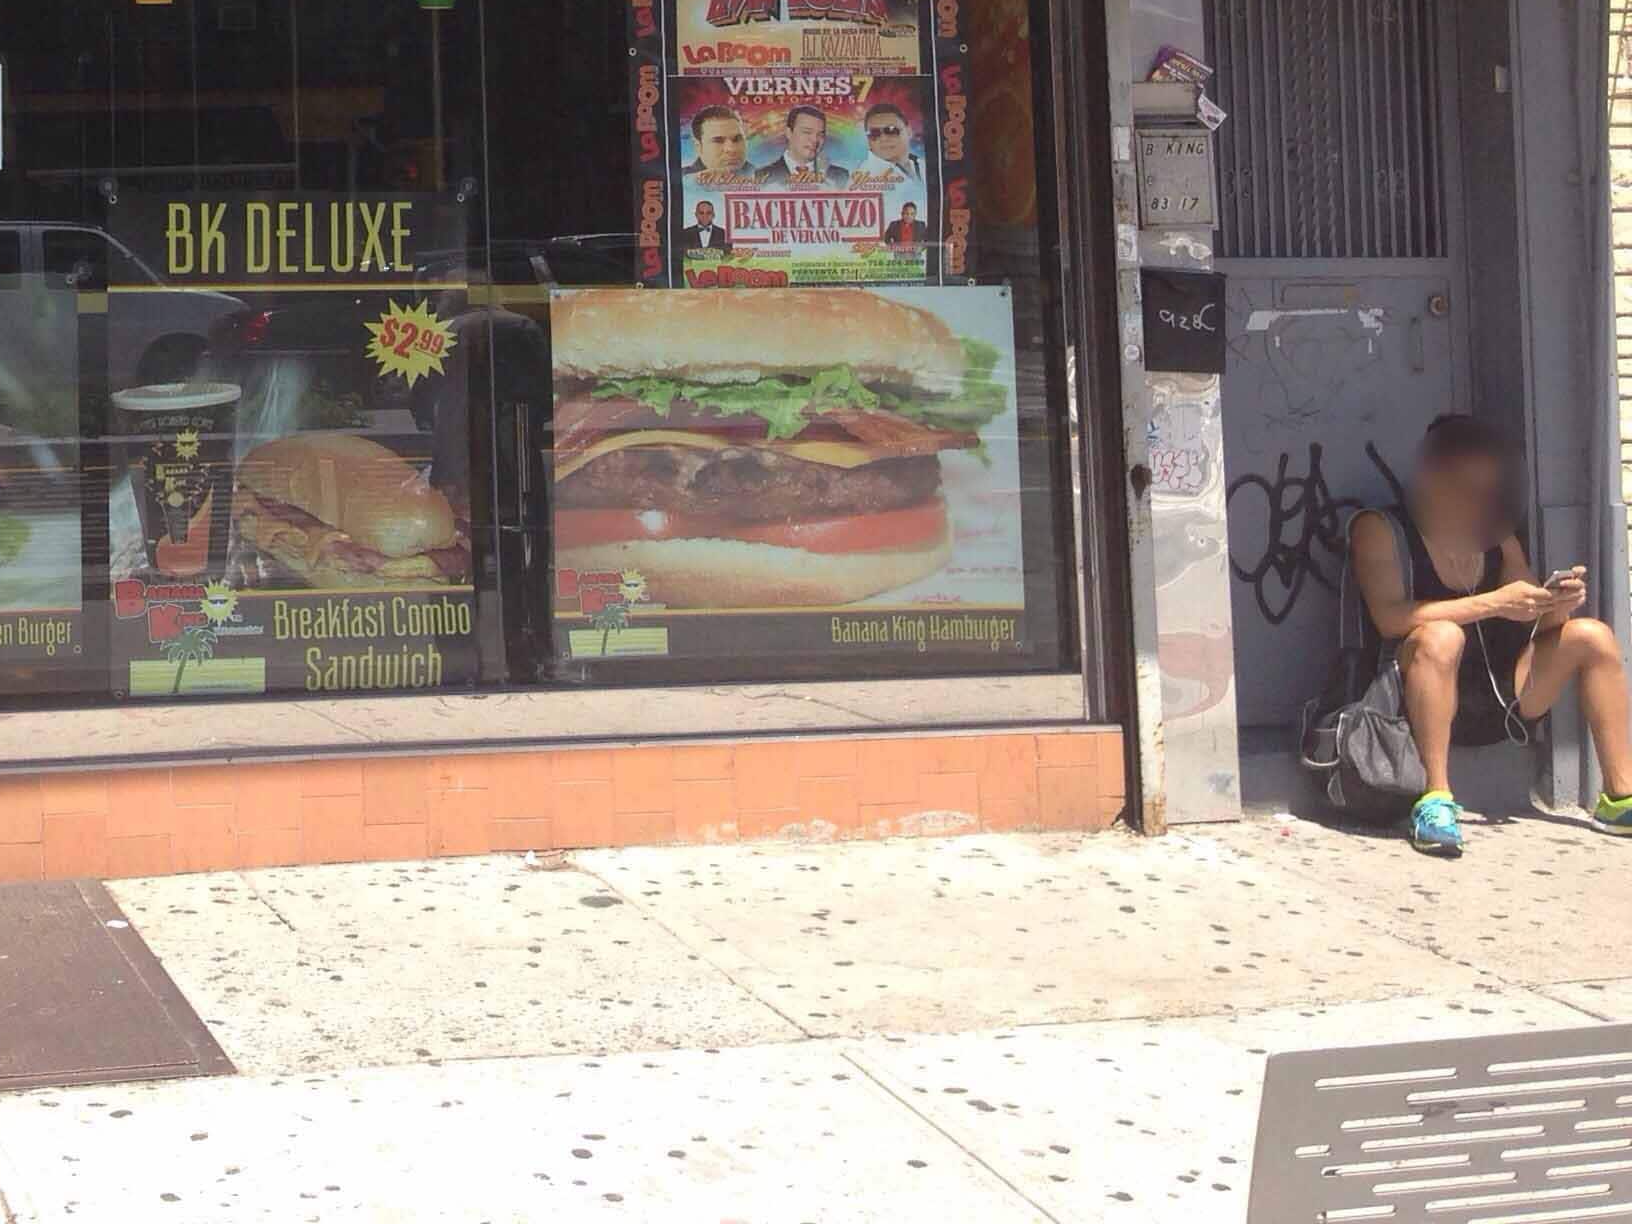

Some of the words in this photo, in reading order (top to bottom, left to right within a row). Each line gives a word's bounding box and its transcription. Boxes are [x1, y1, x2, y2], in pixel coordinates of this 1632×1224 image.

[723, 76, 852, 95] VIERNES
[852, 75, 874, 103] 7
[1145, 143, 1154, 156] B
[1166, 142, 1204, 156] KING
[732, 199, 878, 229] BACHATAZO
[1151, 198, 1169, 210] 83
[1181, 198, 1199, 210] 17
[166, 202, 227, 274] BK
[246, 202, 414, 273] DELUXE
[771, 229, 787, 244] DE
[789, 228, 841, 244] VERANO
[380, 317, 445, 360] $2.99
[17, 616, 72, 656] Burger
[273, 598, 386, 640] Breakfast
[391, 596, 471, 637] Combo
[831, 616, 889, 643] Banana
[891, 615, 927, 652] King
[929, 614, 1015, 652] Hamburger
[305, 644, 443, 691] Sandwich
